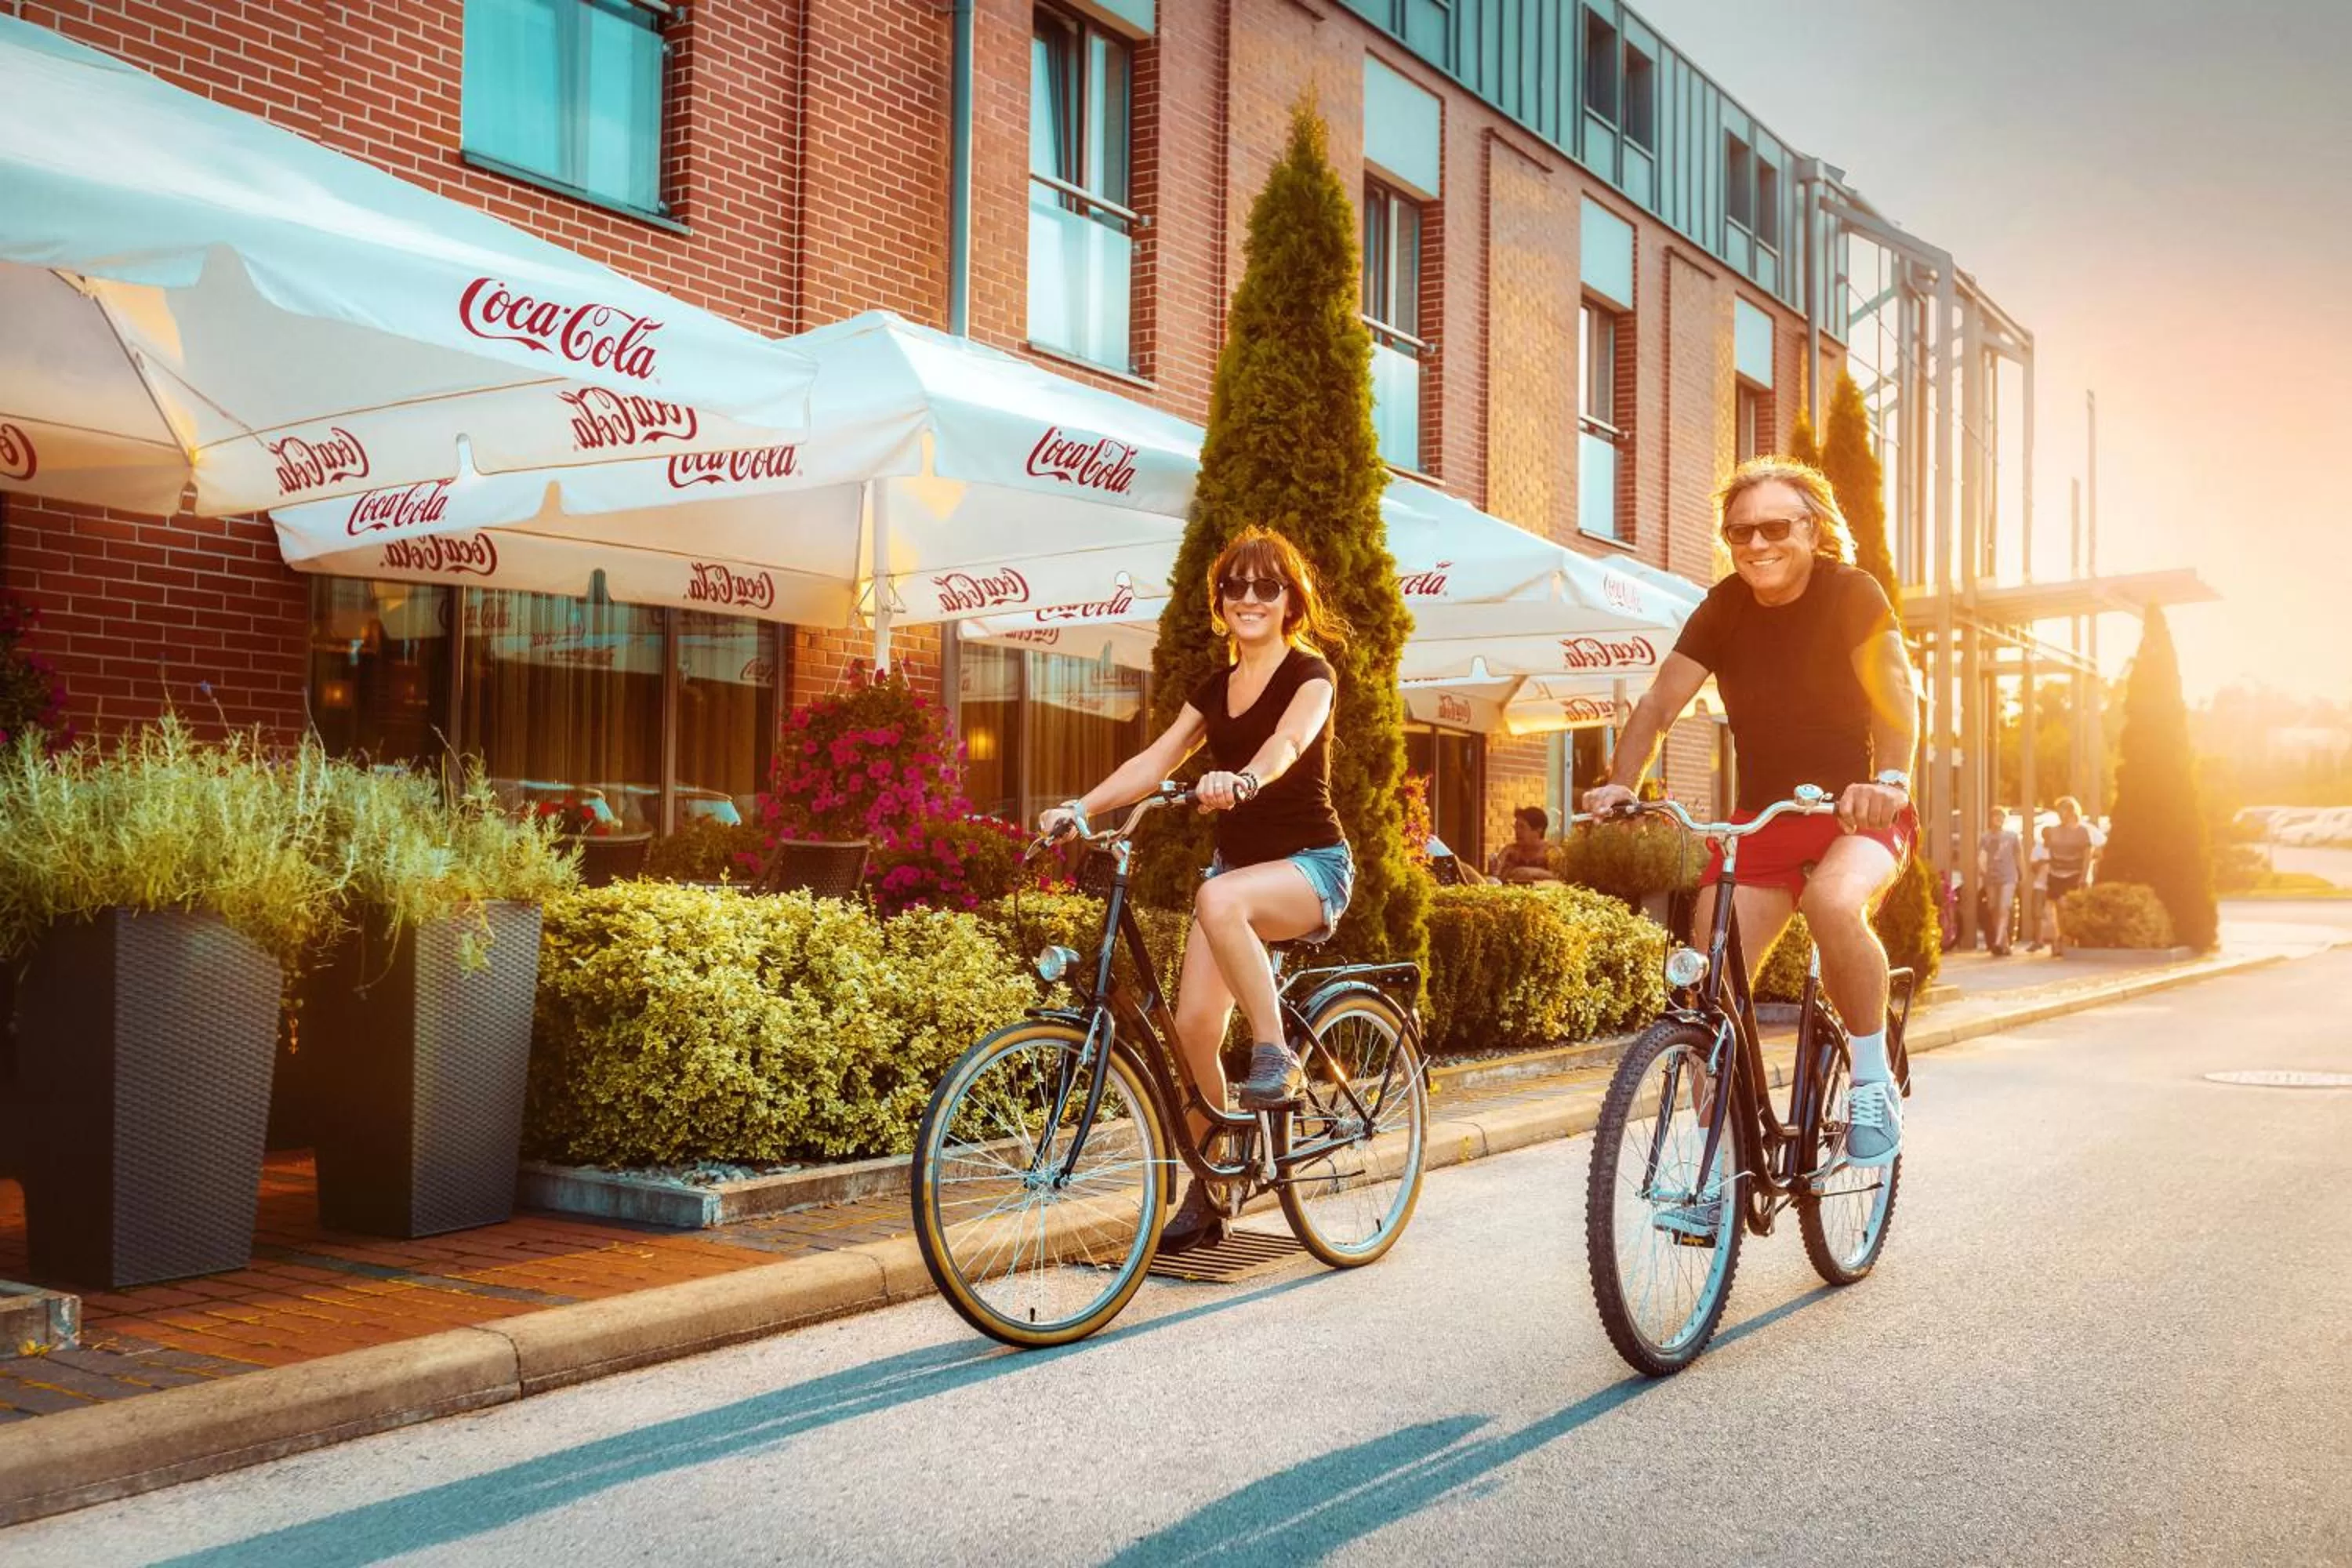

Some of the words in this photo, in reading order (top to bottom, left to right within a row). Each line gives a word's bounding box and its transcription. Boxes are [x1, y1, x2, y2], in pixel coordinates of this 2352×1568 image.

[459, 278, 665, 379] Coca-Cola
[668, 445, 797, 488] CocaCola
[1026, 426, 1138, 493] Coca-Cola
[347, 477, 457, 536] Coca-Cola
